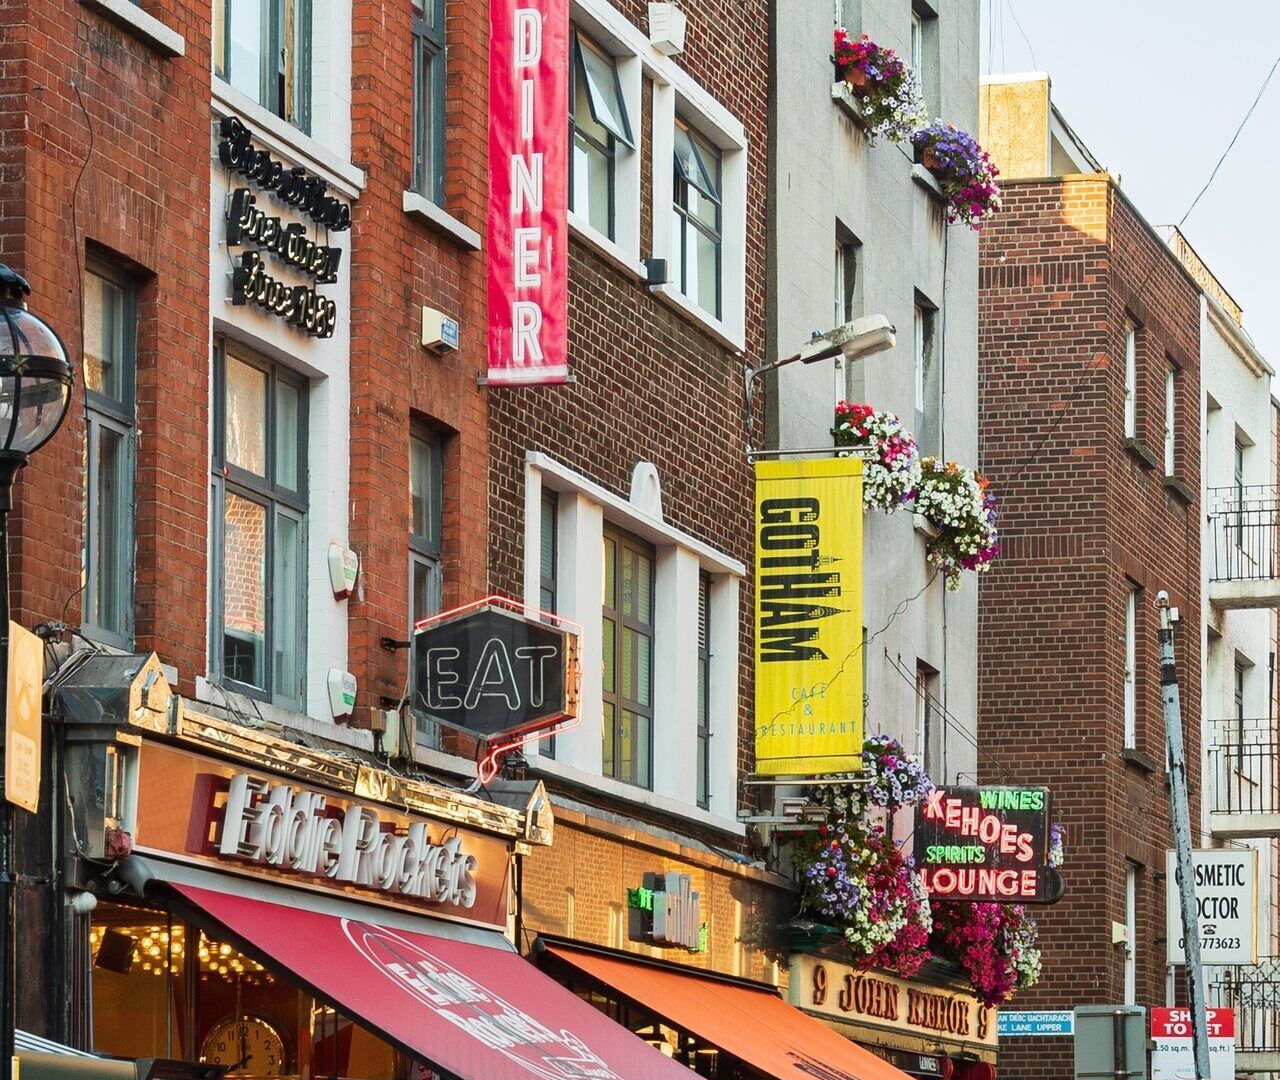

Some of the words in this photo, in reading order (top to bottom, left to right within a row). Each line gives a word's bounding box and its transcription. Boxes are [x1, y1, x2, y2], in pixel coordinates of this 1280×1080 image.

[511, 8, 544, 363] DINER
[760, 496, 842, 663] GOTHAM
[425, 637, 558, 711] EAT
[804, 703, 813, 717] &
[761, 720, 858, 737] RESTAURANT
[979, 790, 1044, 810] WINES
[925, 789, 1034, 862] KEHOES
[220, 774, 344, 878] Eddie
[336, 805, 479, 908] Rockets
[926, 845, 986, 864] SPIRITS
[920, 868, 1037, 896] LOUNGE
[1175, 864, 1245, 886] CSMETIC
[813, 964, 829, 1005] 9
[839, 973, 899, 1021] JOHN
[1170, 1010, 1217, 1021] SHP
[1011, 1024, 1032, 1032] LANE
[1037, 1024, 1062, 1032] UPPER
[1164, 1023, 1187, 1035] TO
